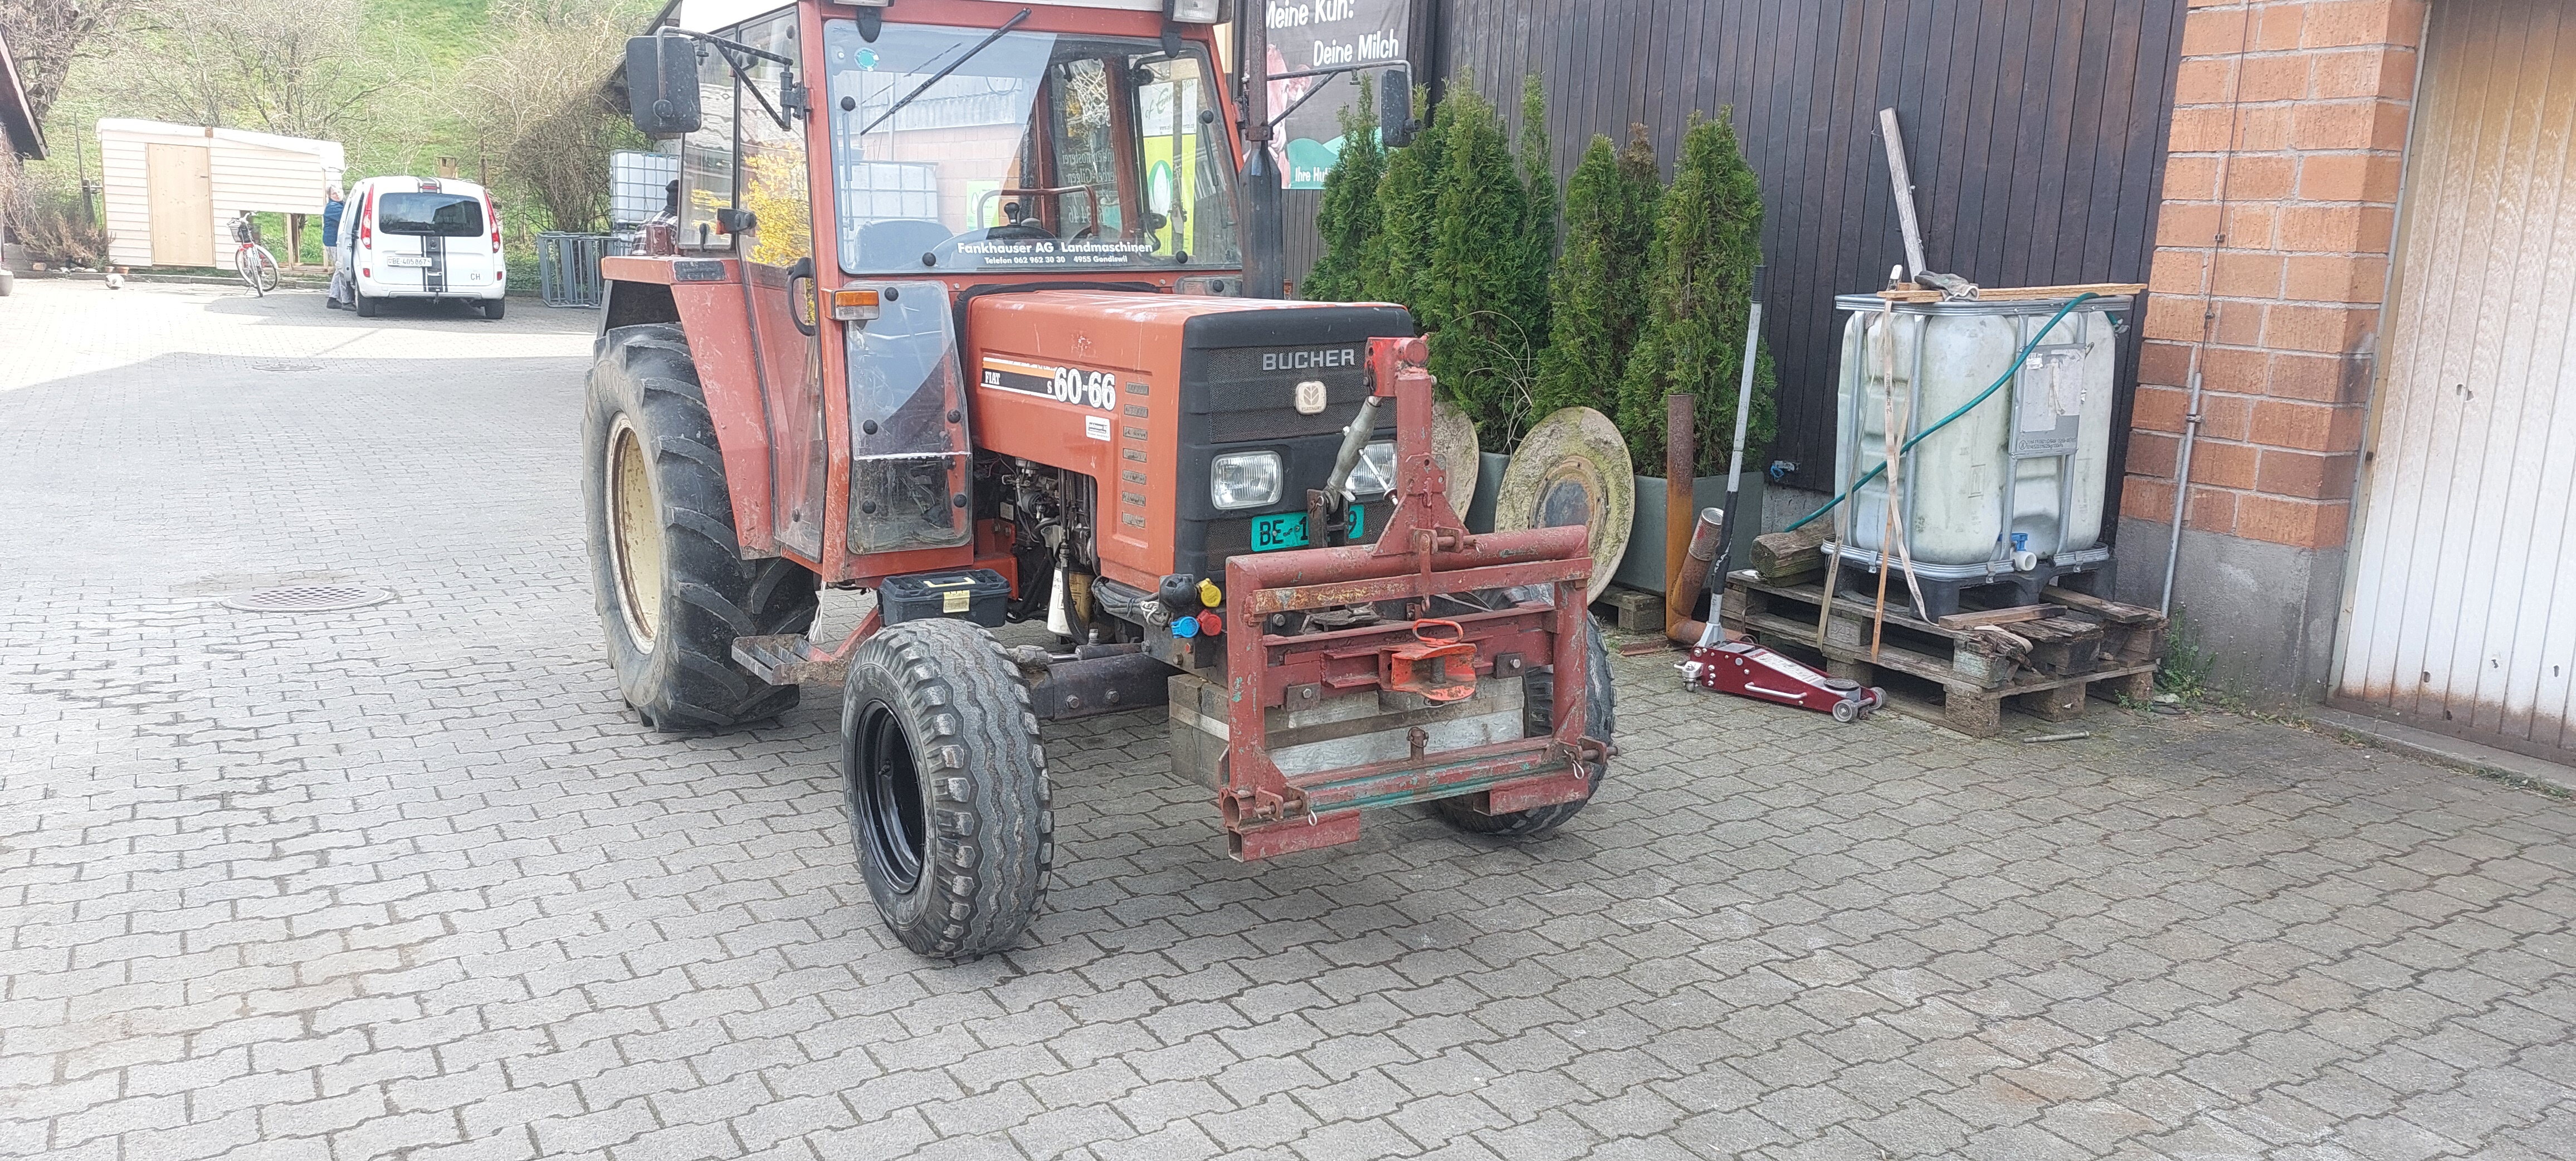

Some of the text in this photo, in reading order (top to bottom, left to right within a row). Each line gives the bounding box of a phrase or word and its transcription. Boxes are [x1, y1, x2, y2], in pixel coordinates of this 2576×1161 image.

[1314, 28, 1399, 66] Deine Milch
[1295, 166, 1311, 182] Ihre
[957, 241, 1153, 253] Fankhauser AG Landmaschinen
[1262, 349, 1355, 370] BUCHER
[984, 370, 1001, 386] FIAT
[1055, 366, 1116, 412] 60-66
